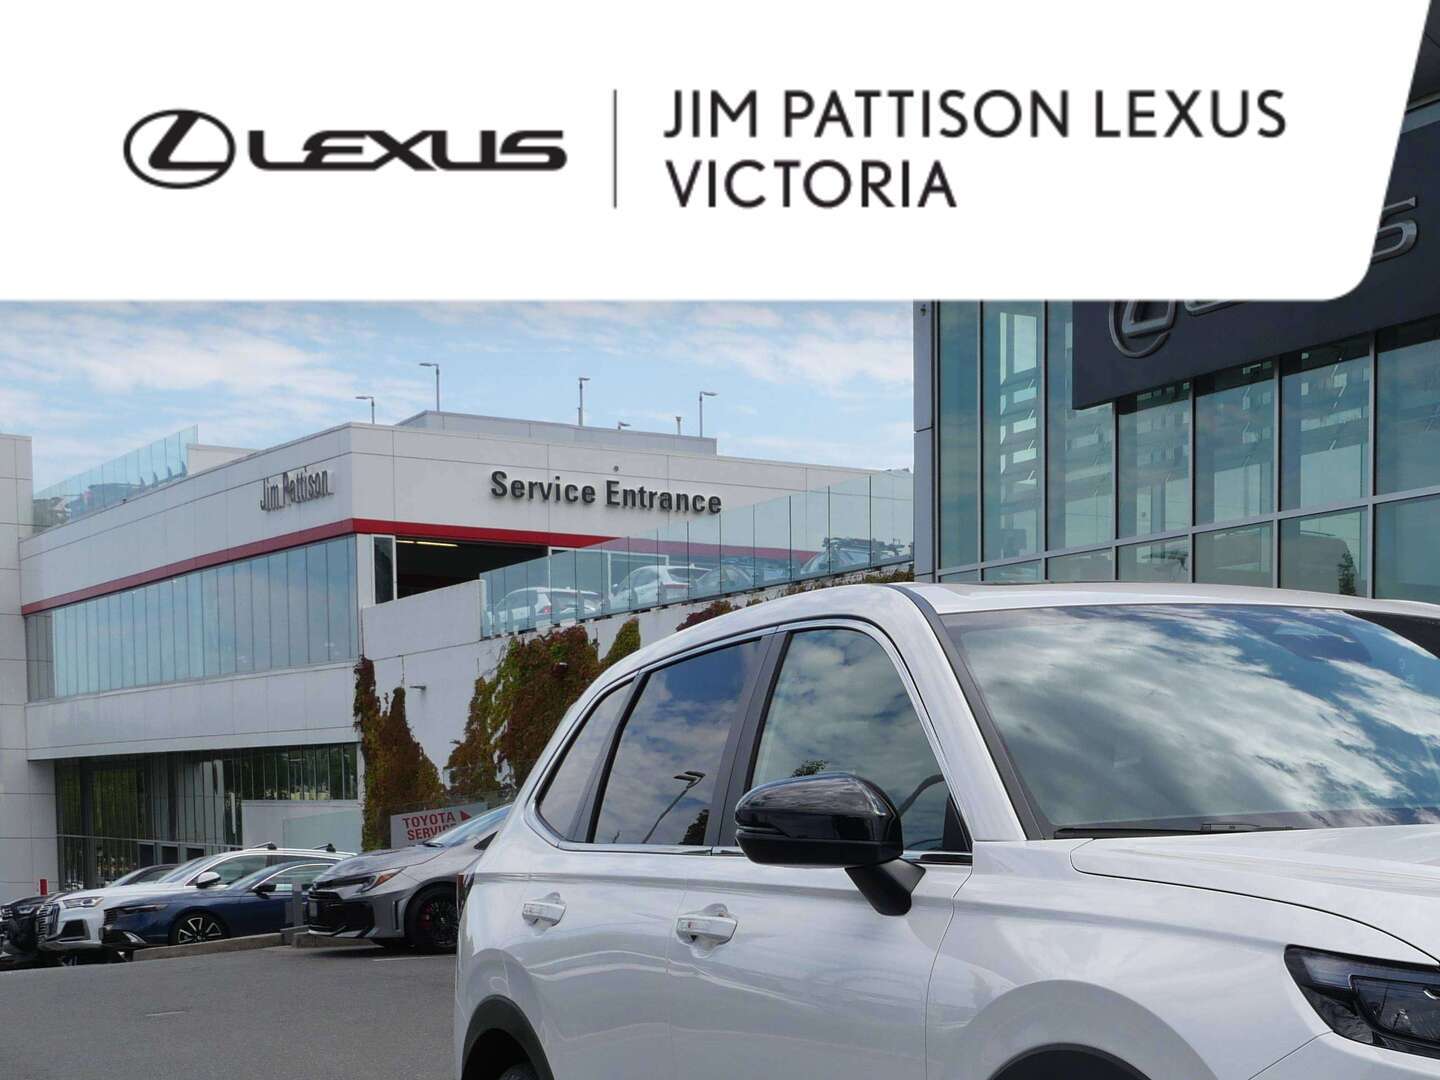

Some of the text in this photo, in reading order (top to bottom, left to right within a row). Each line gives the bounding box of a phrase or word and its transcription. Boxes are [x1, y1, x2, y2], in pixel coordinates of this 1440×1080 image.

[260, 466, 329, 511] Jim Pattison
[491, 470, 722, 514] Service Entrance
[403, 811, 456, 829] TOYOTA
[407, 823, 457, 841] SERVI
